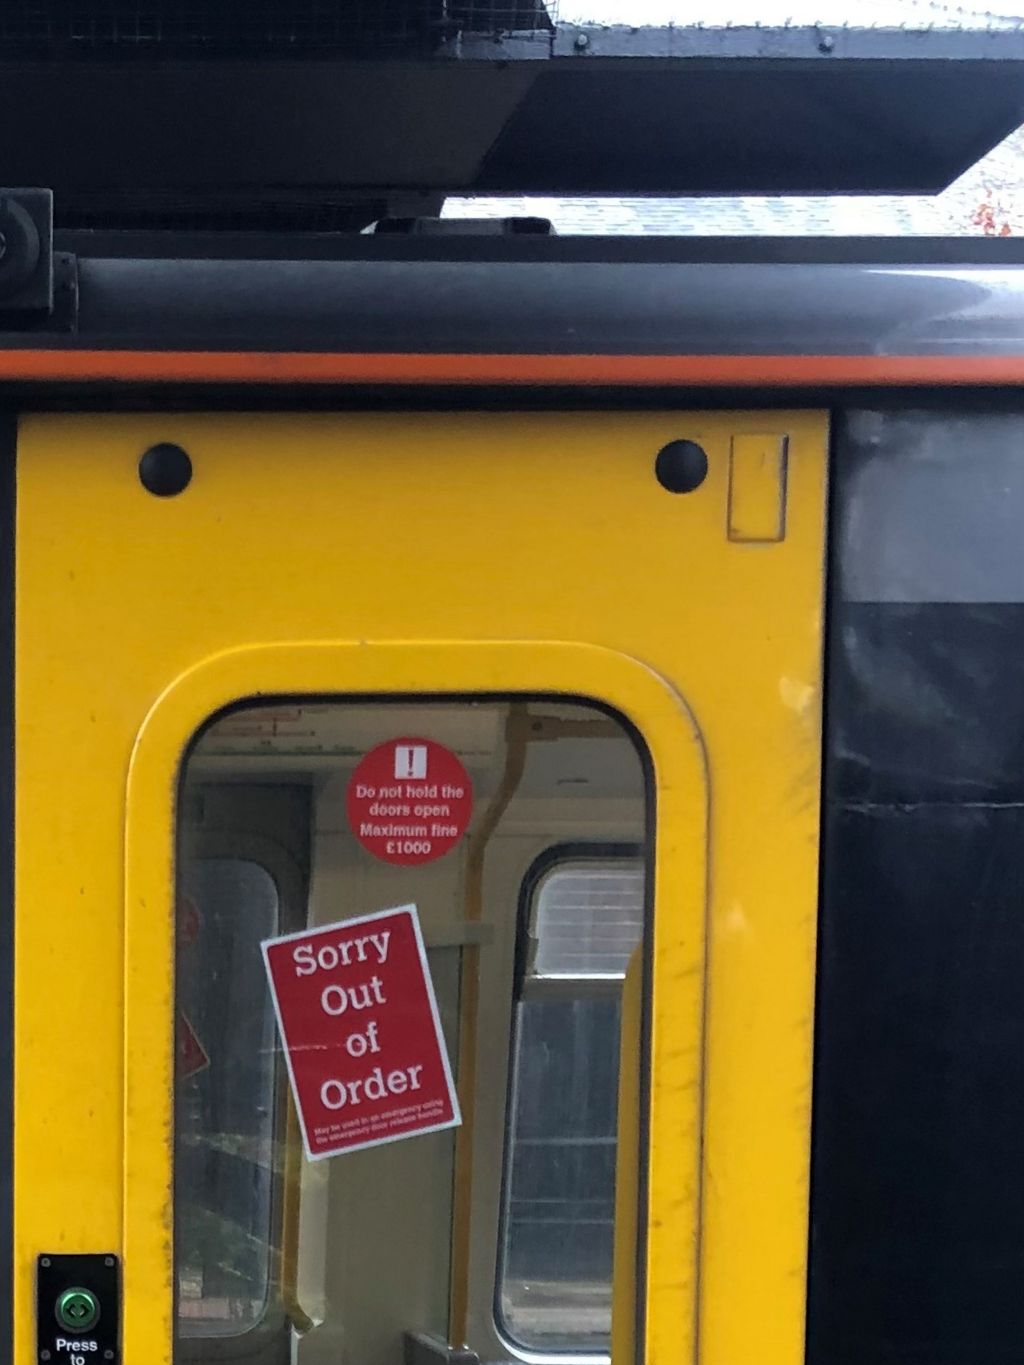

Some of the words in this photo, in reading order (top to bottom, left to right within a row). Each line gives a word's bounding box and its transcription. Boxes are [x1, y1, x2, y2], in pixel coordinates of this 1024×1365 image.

[356, 785, 375, 798] Do
[379, 785, 402, 798] not
[407, 785, 437, 798] hold
[442, 785, 464, 798] the
[370, 803, 410, 816] doors
[415, 805, 449, 818] open
[361, 823, 426, 836] Maximum
[432, 824, 457, 836] fine
[387, 842, 431, 854] £1000
[293, 931, 391, 977] Sorry
[321, 976, 387, 1016] Out
[346, 1022, 381, 1057] of
[320, 1064, 423, 1110] Order
[57, 1338, 98, 1352] Press
